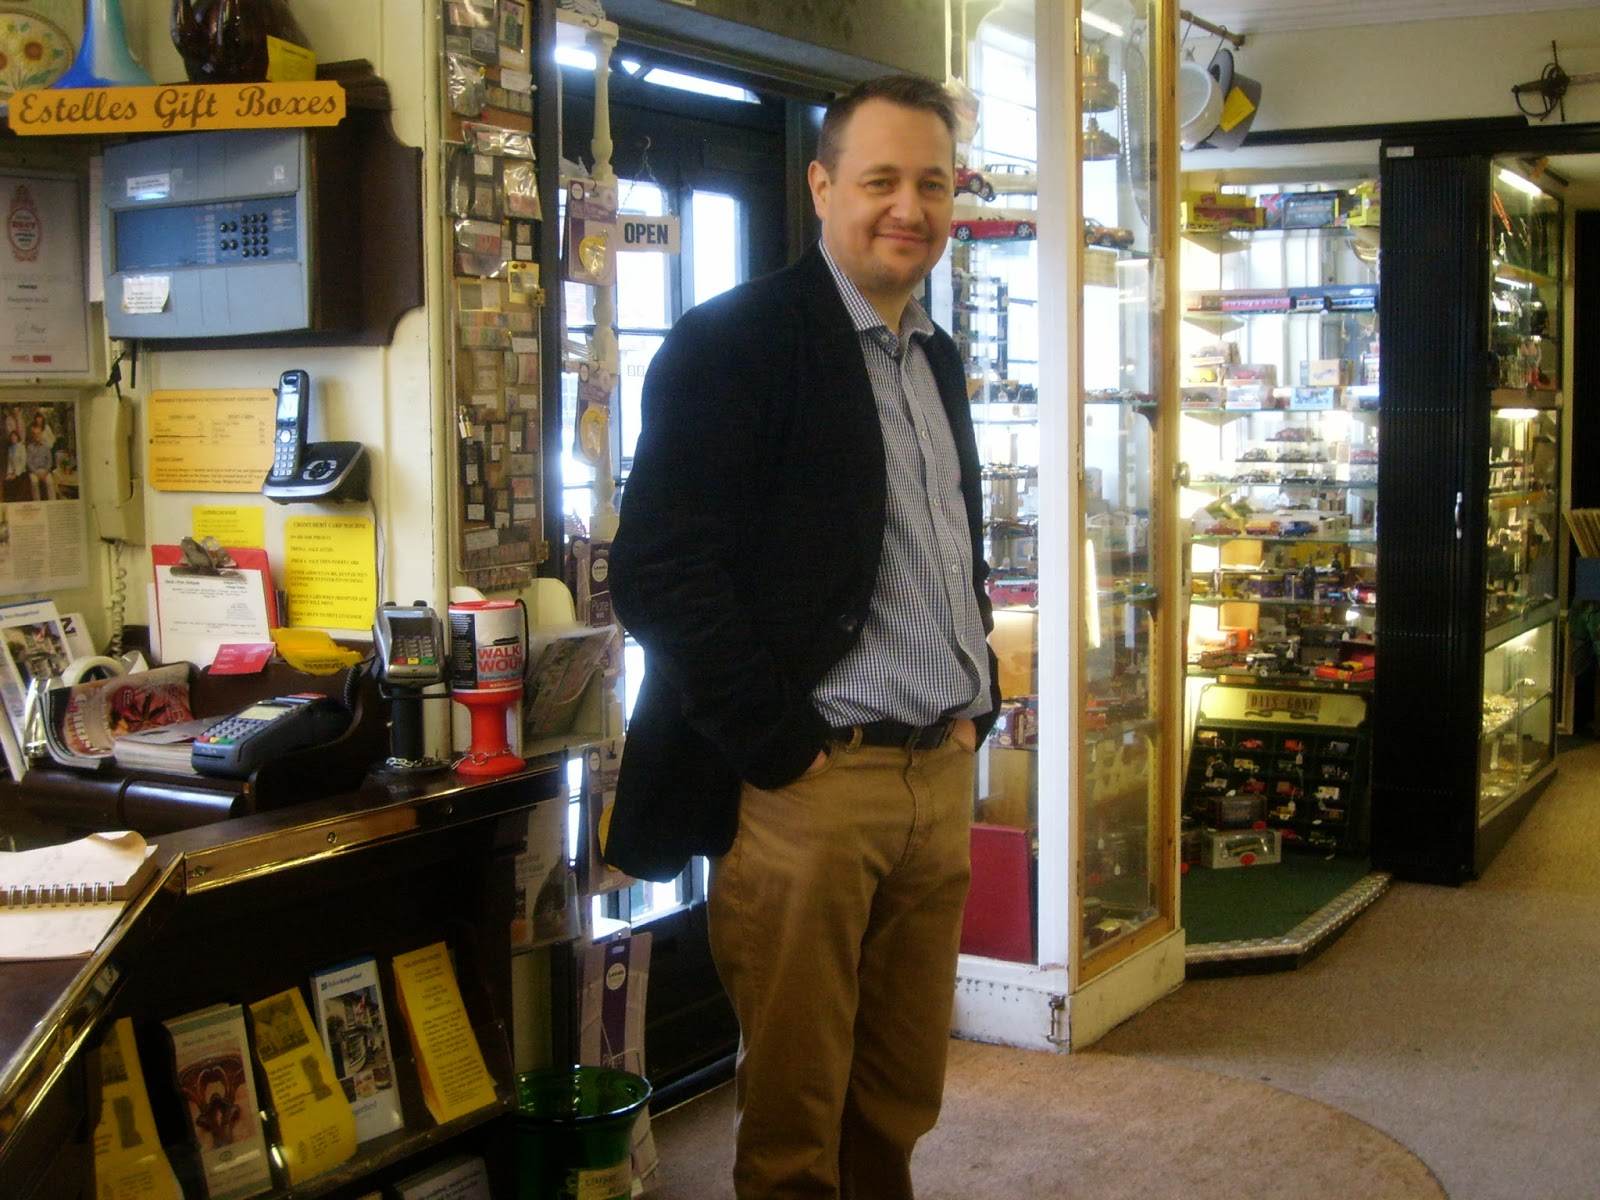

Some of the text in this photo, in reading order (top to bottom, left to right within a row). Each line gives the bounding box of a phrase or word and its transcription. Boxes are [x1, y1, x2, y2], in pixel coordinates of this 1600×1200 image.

[19, 85, 338, 129] Estelles Gift Boxes
[624, 222, 669, 245] OPEN
[302, 662, 348, 670] RESERVED
